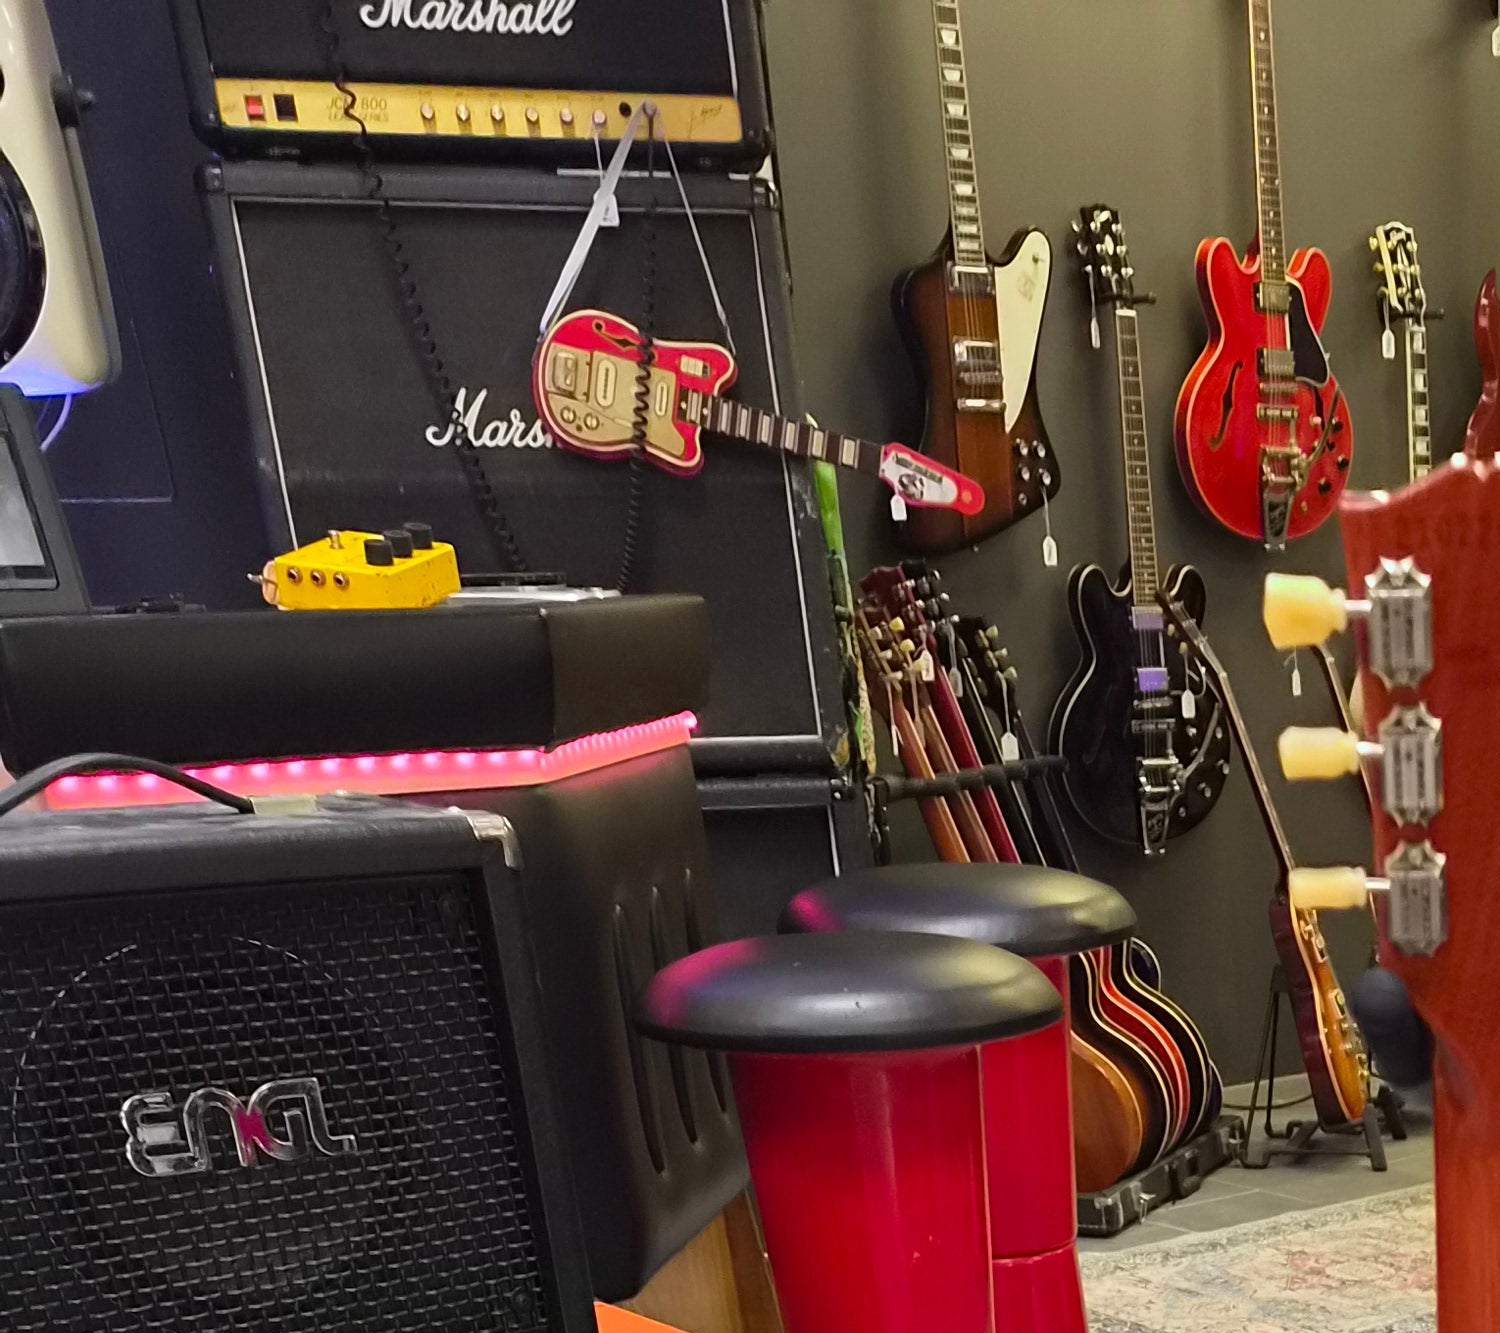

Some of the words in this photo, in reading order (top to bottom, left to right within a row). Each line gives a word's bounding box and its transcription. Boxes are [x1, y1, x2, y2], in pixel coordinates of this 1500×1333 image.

[359, 0, 576, 36] Marshall
[425, 387, 553, 448] Mars
[120, 1077, 357, 1177] ENGL
